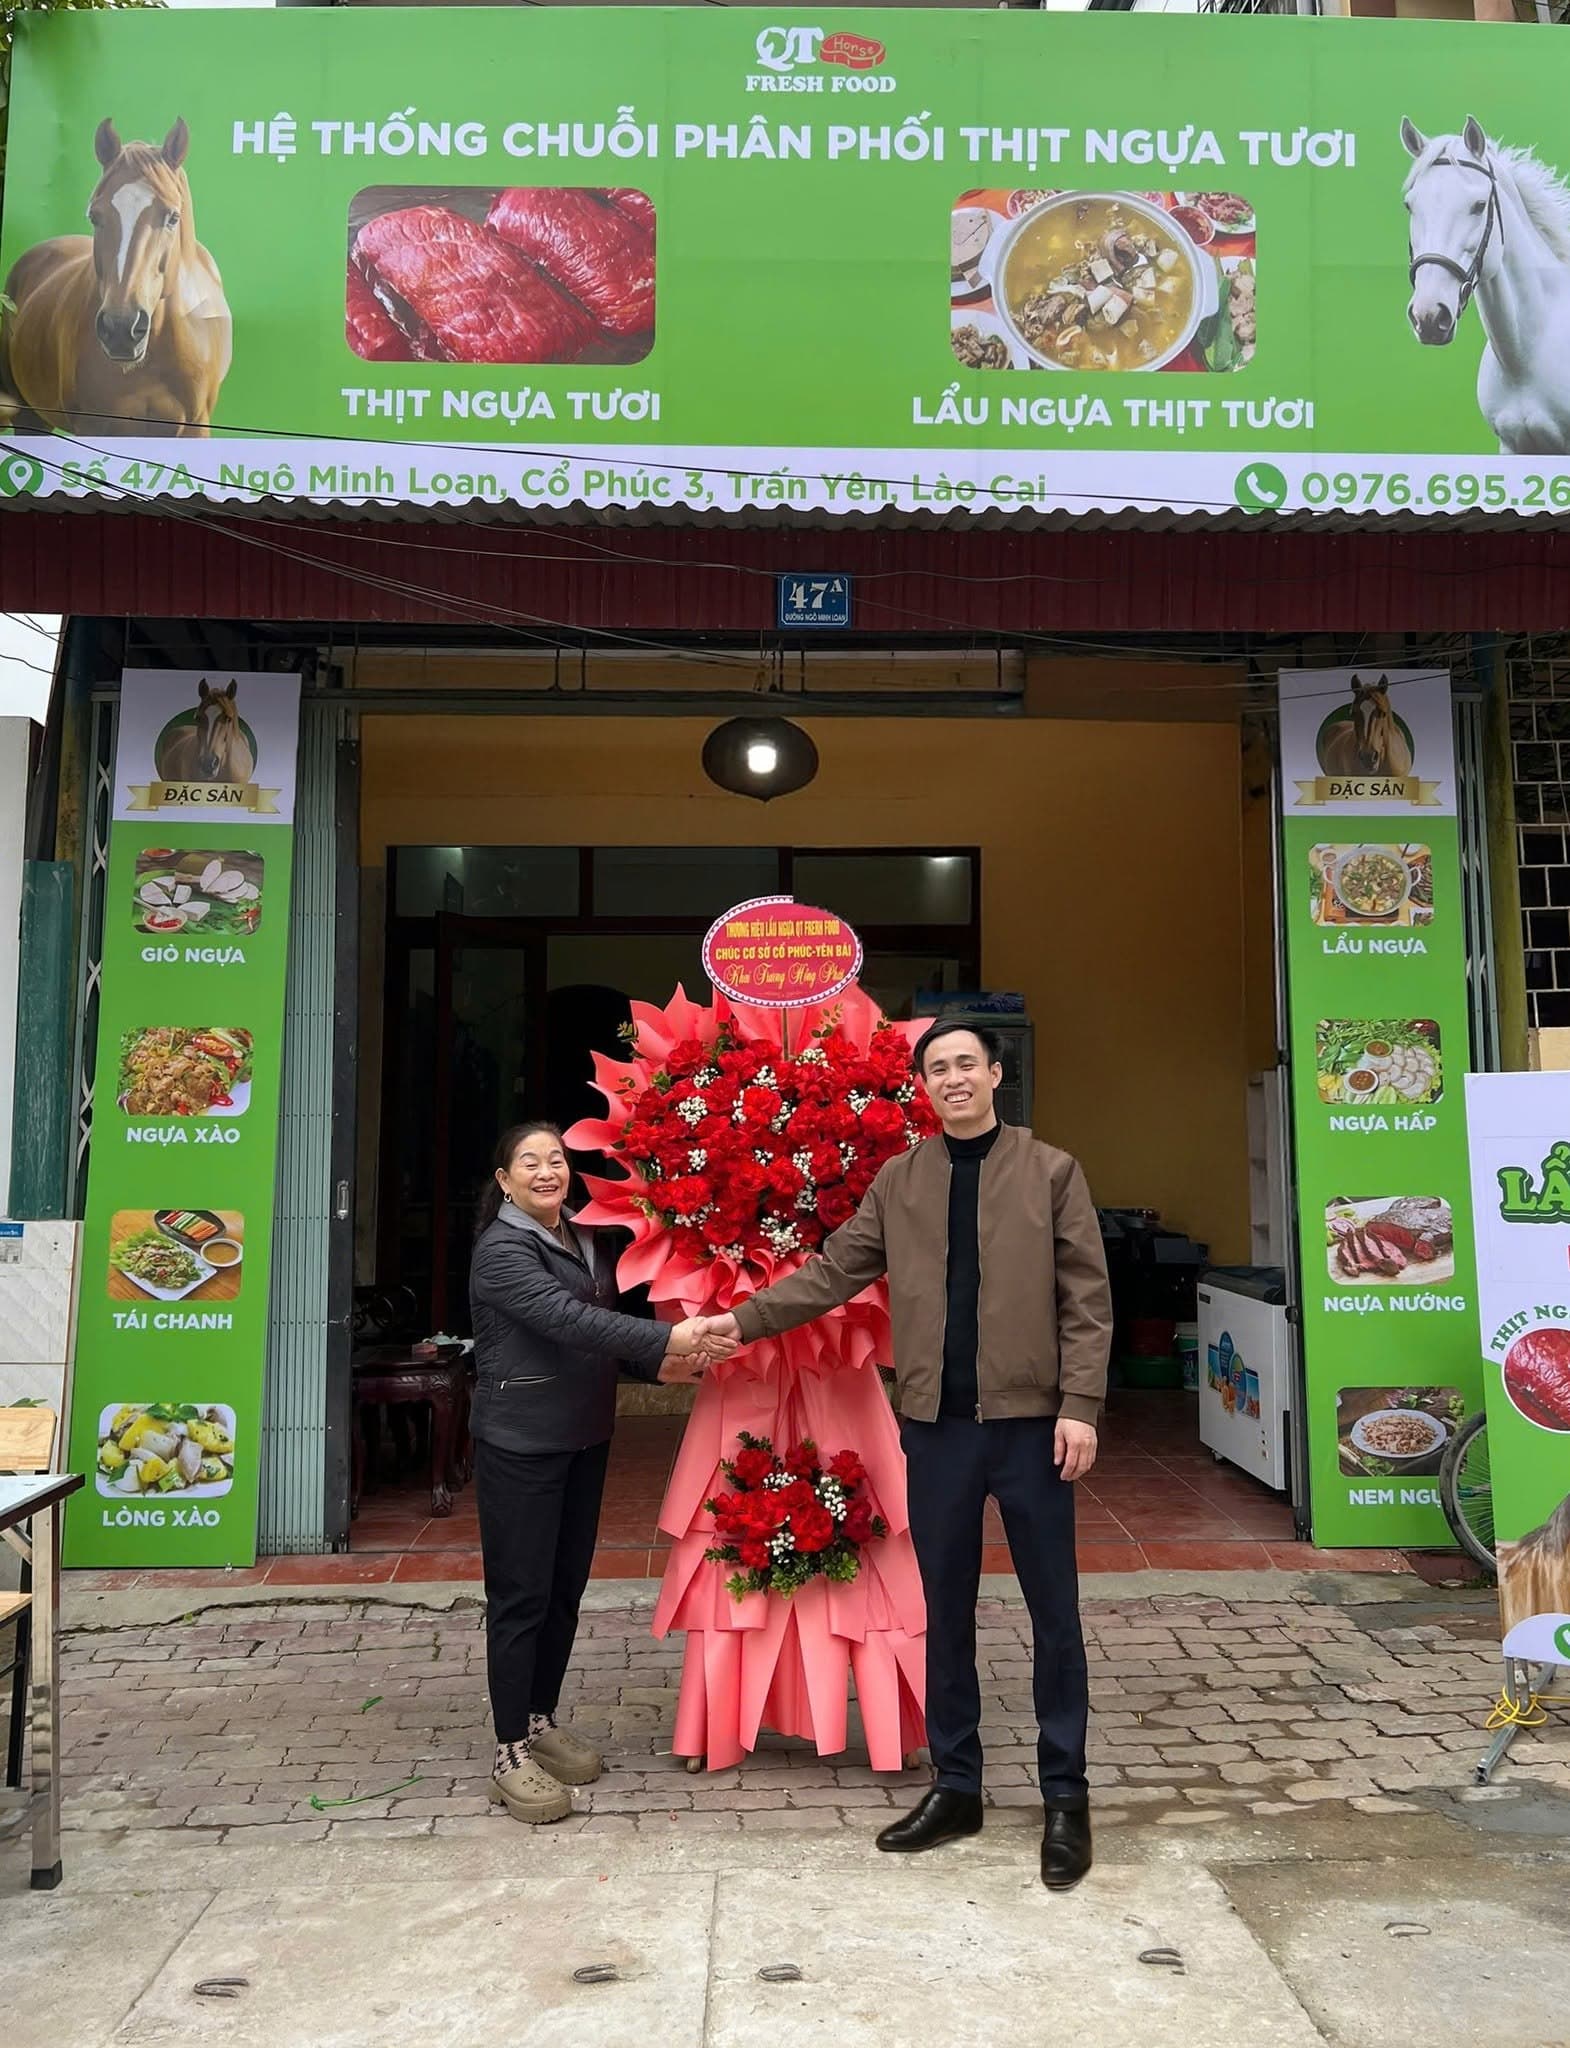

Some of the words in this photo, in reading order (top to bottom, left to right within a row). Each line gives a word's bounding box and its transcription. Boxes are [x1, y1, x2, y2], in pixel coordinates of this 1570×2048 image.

[756, 26, 825, 72] QT
[745, 75, 824, 92] FRESH
[831, 76, 897, 93] FOOD
[231, 111, 297, 163] HỆ
[311, 107, 488, 158] THỐNG
[502, 105, 659, 159] CHUỖI
[675, 114, 812, 160] PHÂN
[827, 111, 945, 161] PHỐI
[960, 126, 1071, 171] THỊT
[1084, 124, 1225, 174] NGỰA
[1238, 126, 1356, 168] TƯƠI
[341, 388, 430, 424] THỊT
[442, 387, 555, 426] NGỰA
[567, 388, 661, 422] TƯƠI
[912, 382, 990, 427] LẨU
[1001, 395, 1112, 433] NGỰA
[1124, 399, 1211, 434] THỊT
[1221, 398, 1315, 430] TƯƠI
[60, 456, 110, 489] Số
[120, 463, 205, 494] 47A,
[219, 463, 295, 497] Ngô
[309, 465, 395, 493] Minh
[409, 467, 507, 500] Loan,
[521, 460, 570, 496] Cổ
[584, 468, 671, 498] Phúc
[684, 471, 714, 504] 3,
[727, 466, 807, 500] Trấn
[820, 472, 898, 504] Yên,
[912, 472, 977, 502] Lào
[990, 474, 1046, 502] Cai
[1302, 472, 1570, 506] 0976.695.26
[164, 785, 202, 805] ĐẶC
[206, 785, 243, 802] SẢN
[1330, 780, 1365, 799] ĐẶC
[1370, 779, 1404, 796] SẢN
[141, 944, 178, 963] GIÒ
[184, 947, 245, 965] NGỰA
[1323, 934, 1364, 955] LẨU
[1368, 938, 1427, 957] NGỰA
[1329, 1115, 1389, 1135] NGỰA
[1394, 1109, 1437, 1131] HẤP
[126, 1127, 188, 1147] NGỰA
[194, 1123, 240, 1144] XÀO
[1497, 1141, 1570, 1223] LẨ
[1323, 1294, 1384, 1315] NGỰA
[1389, 1291, 1466, 1311] NƯỚNG
[113, 1309, 147, 1329] TÁI
[153, 1313, 233, 1330] CHANH
[1490, 1310, 1528, 1351] THỊT
[1349, 1489, 1394, 1505] NEM
[102, 1504, 166, 1528] LÒNG
[171, 1505, 221, 1528] XÀO
